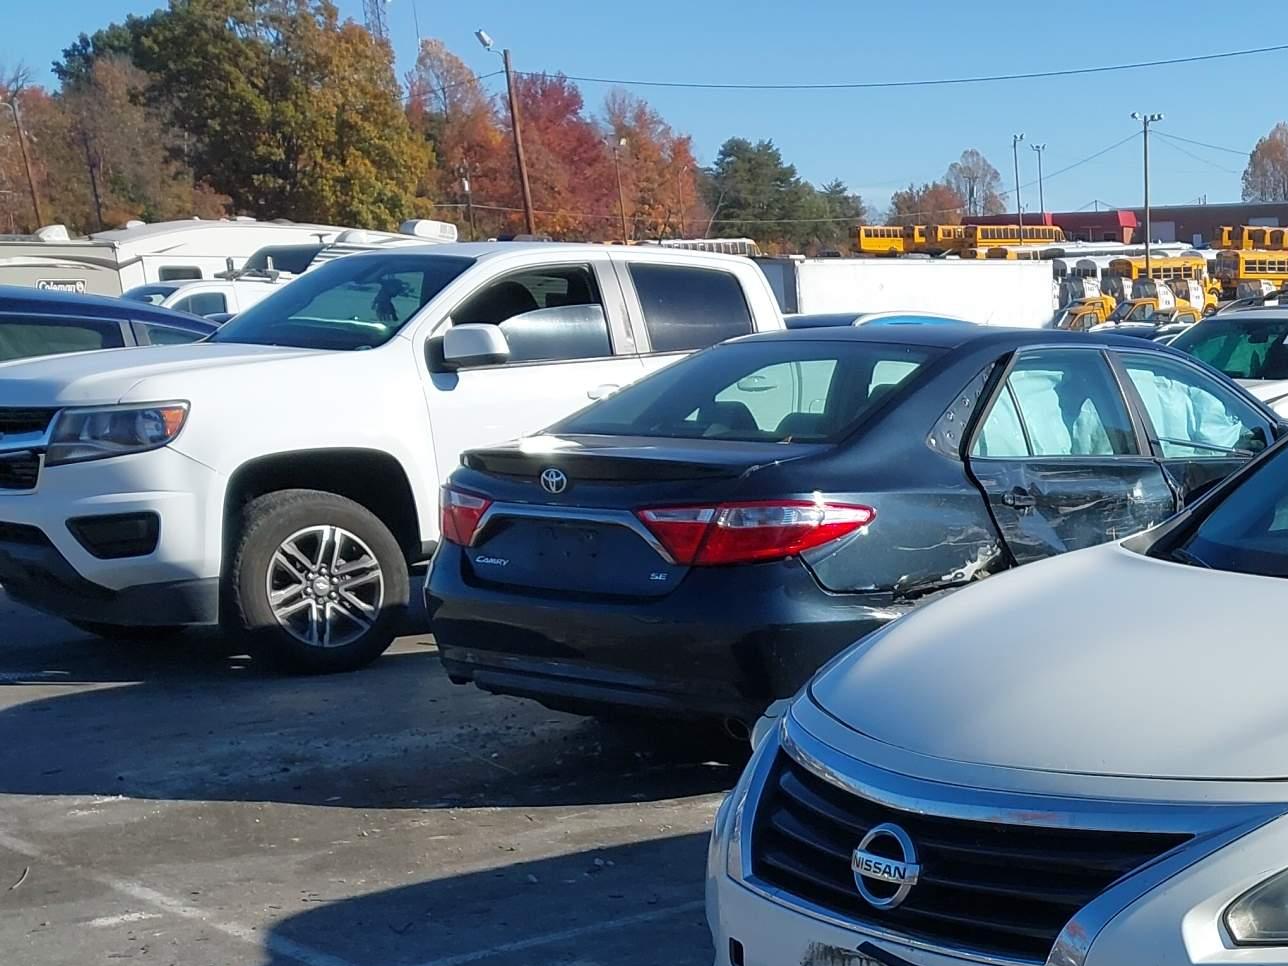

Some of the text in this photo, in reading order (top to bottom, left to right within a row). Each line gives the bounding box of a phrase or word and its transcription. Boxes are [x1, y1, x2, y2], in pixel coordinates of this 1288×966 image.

[475, 555, 510, 566] CAMRY
[649, 572, 668, 580] SE
[854, 852, 906, 879] NISSAN
